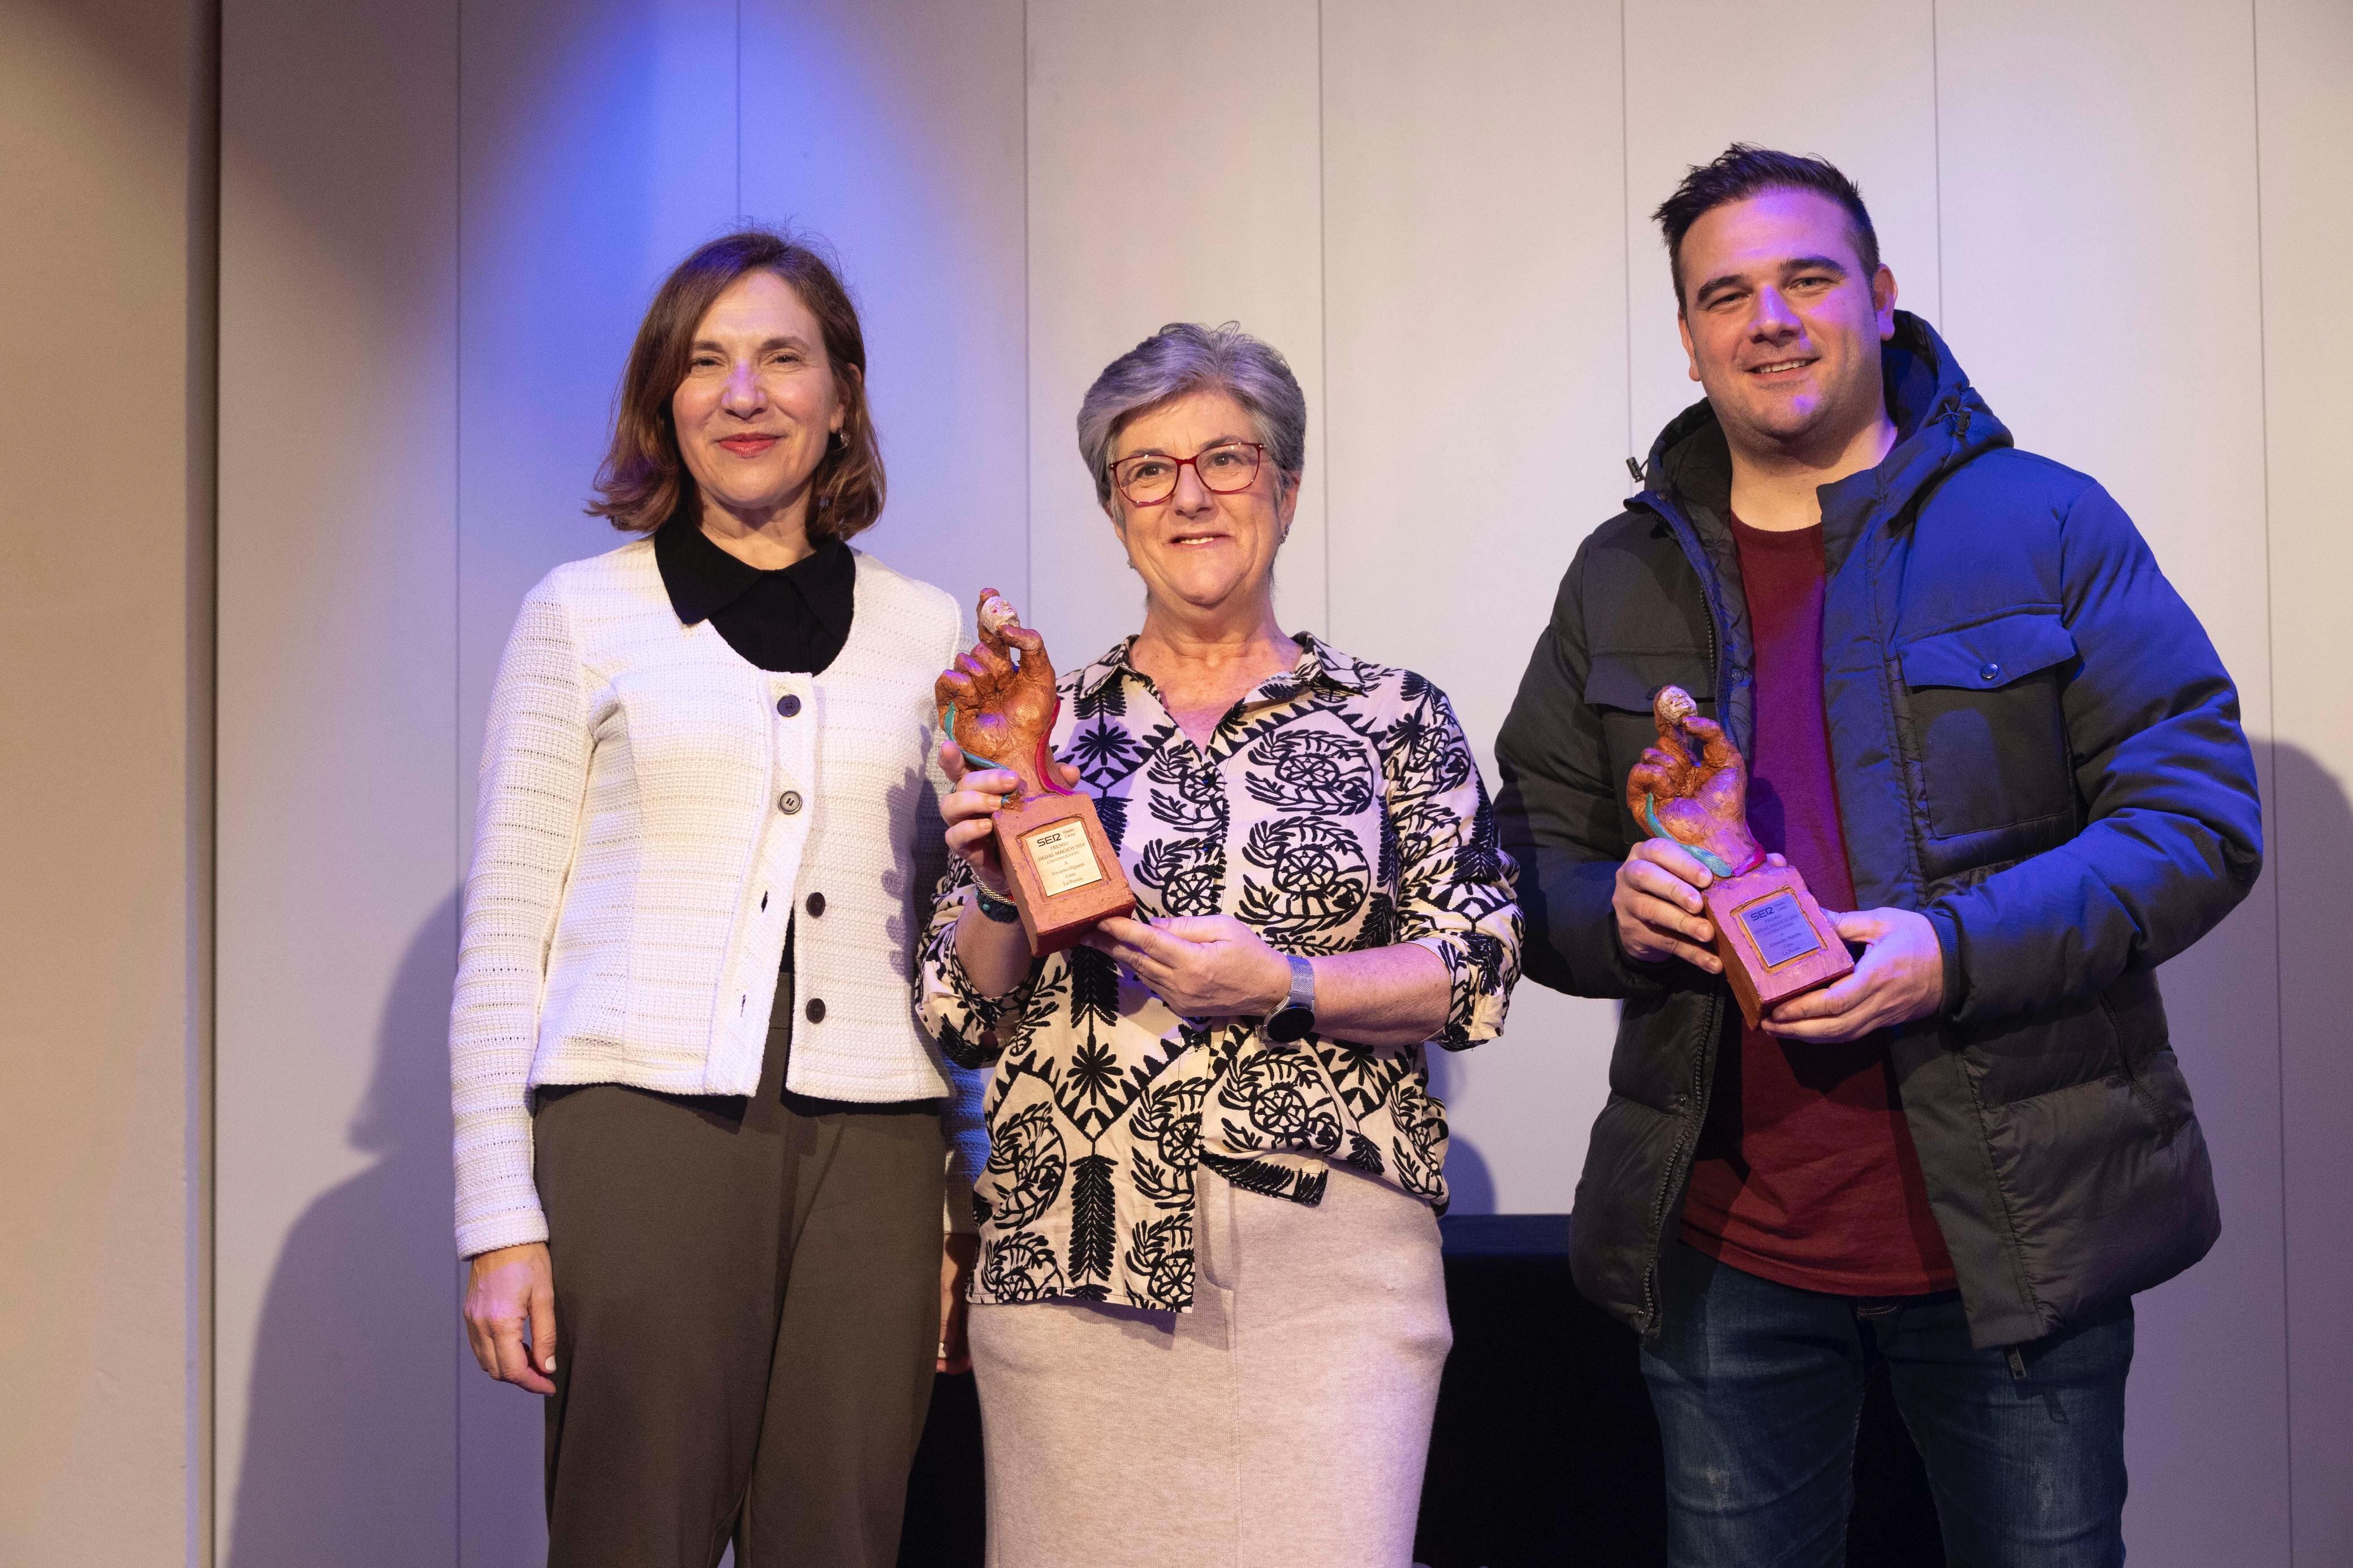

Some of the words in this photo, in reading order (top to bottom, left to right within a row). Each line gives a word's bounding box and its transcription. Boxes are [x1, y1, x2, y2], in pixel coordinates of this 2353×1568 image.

[1037, 833, 1062, 847] SER
[1050, 842, 1068, 850] PREMIO
[1055, 846, 1074, 855] MÁGICO
[1751, 907, 1774, 921] SER
[1765, 914, 1782, 923] PREMIO
